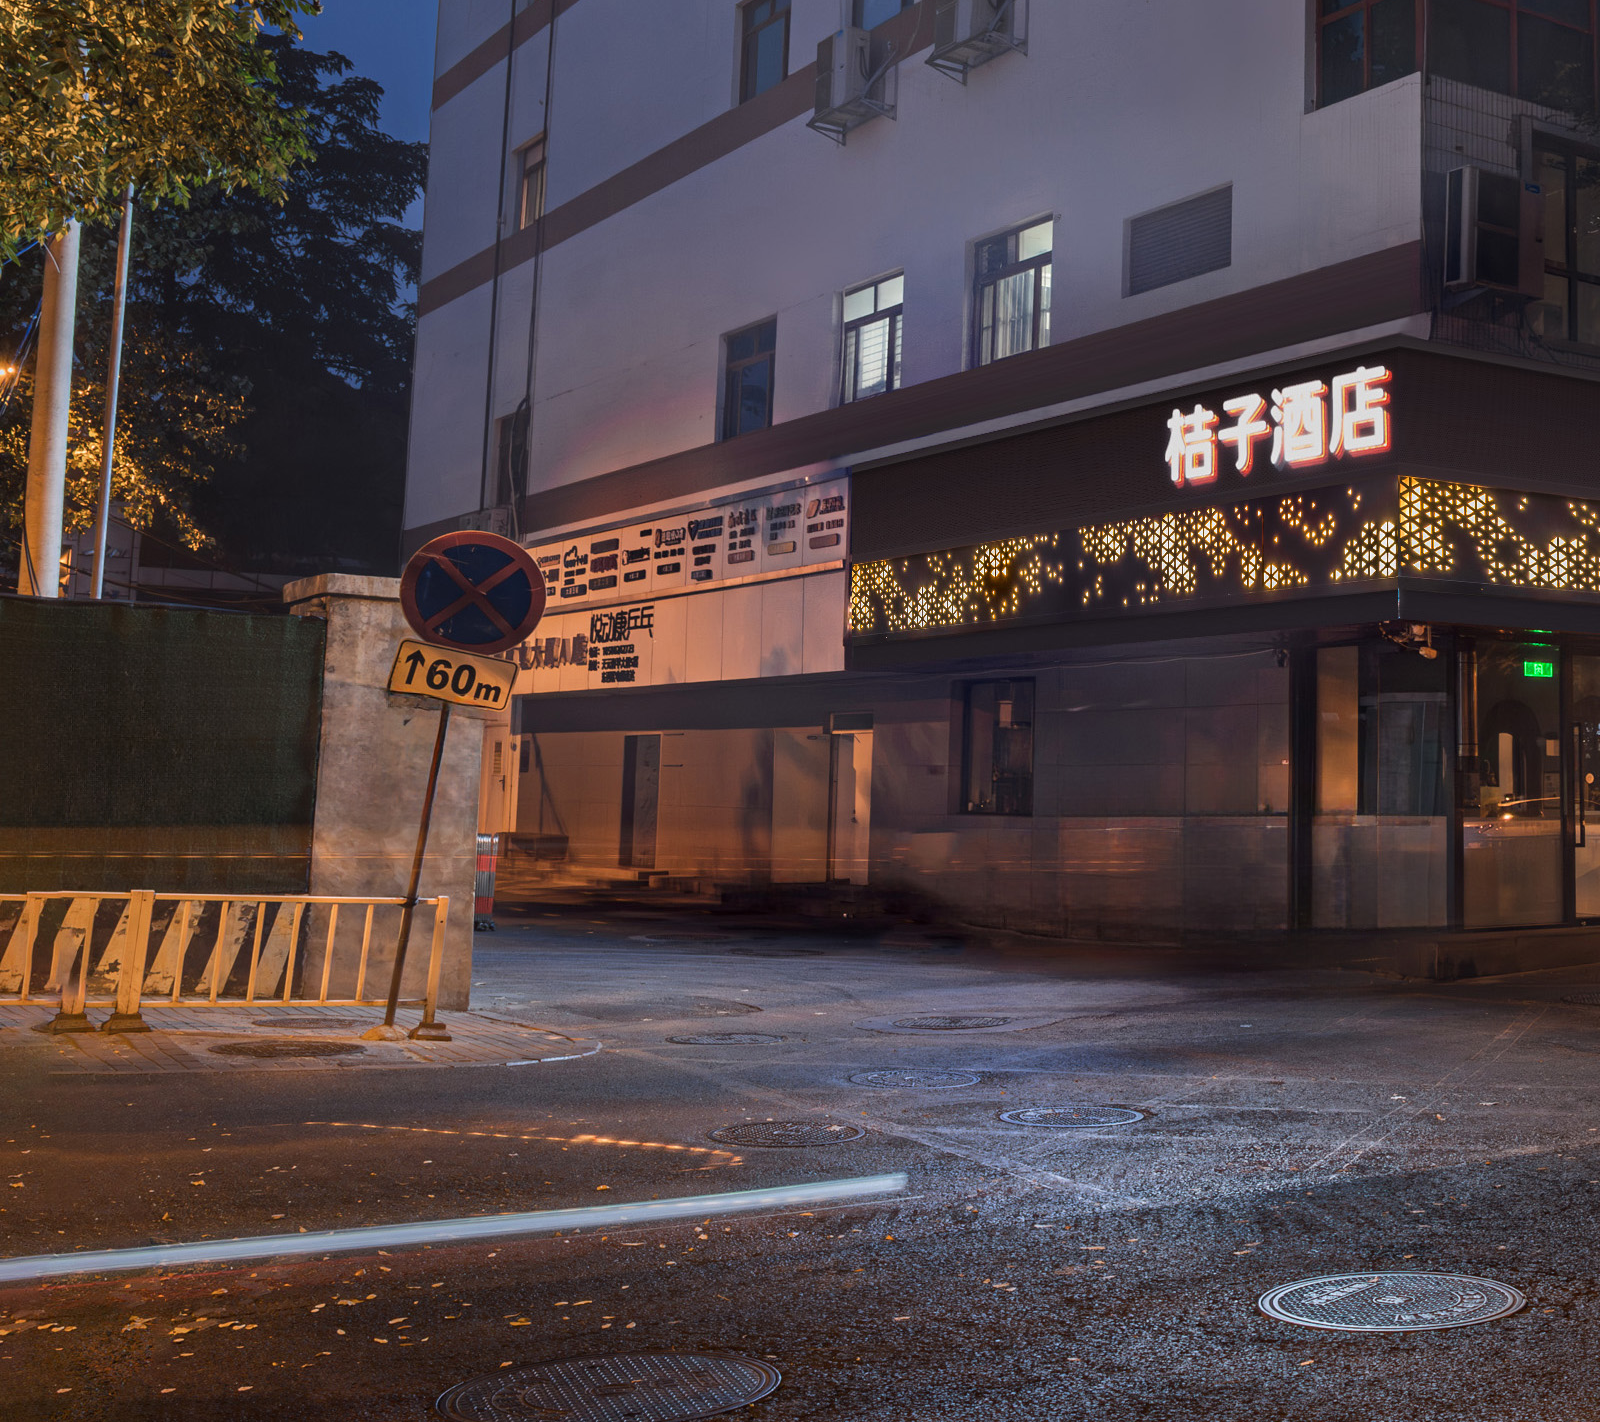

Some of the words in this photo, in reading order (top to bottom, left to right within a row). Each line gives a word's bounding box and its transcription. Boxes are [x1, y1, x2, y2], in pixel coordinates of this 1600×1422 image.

[1165, 365, 1390, 486] 桔子酒店
[590, 606, 654, 643] 悦动康乒乓
[426, 659, 501, 702] 60m
